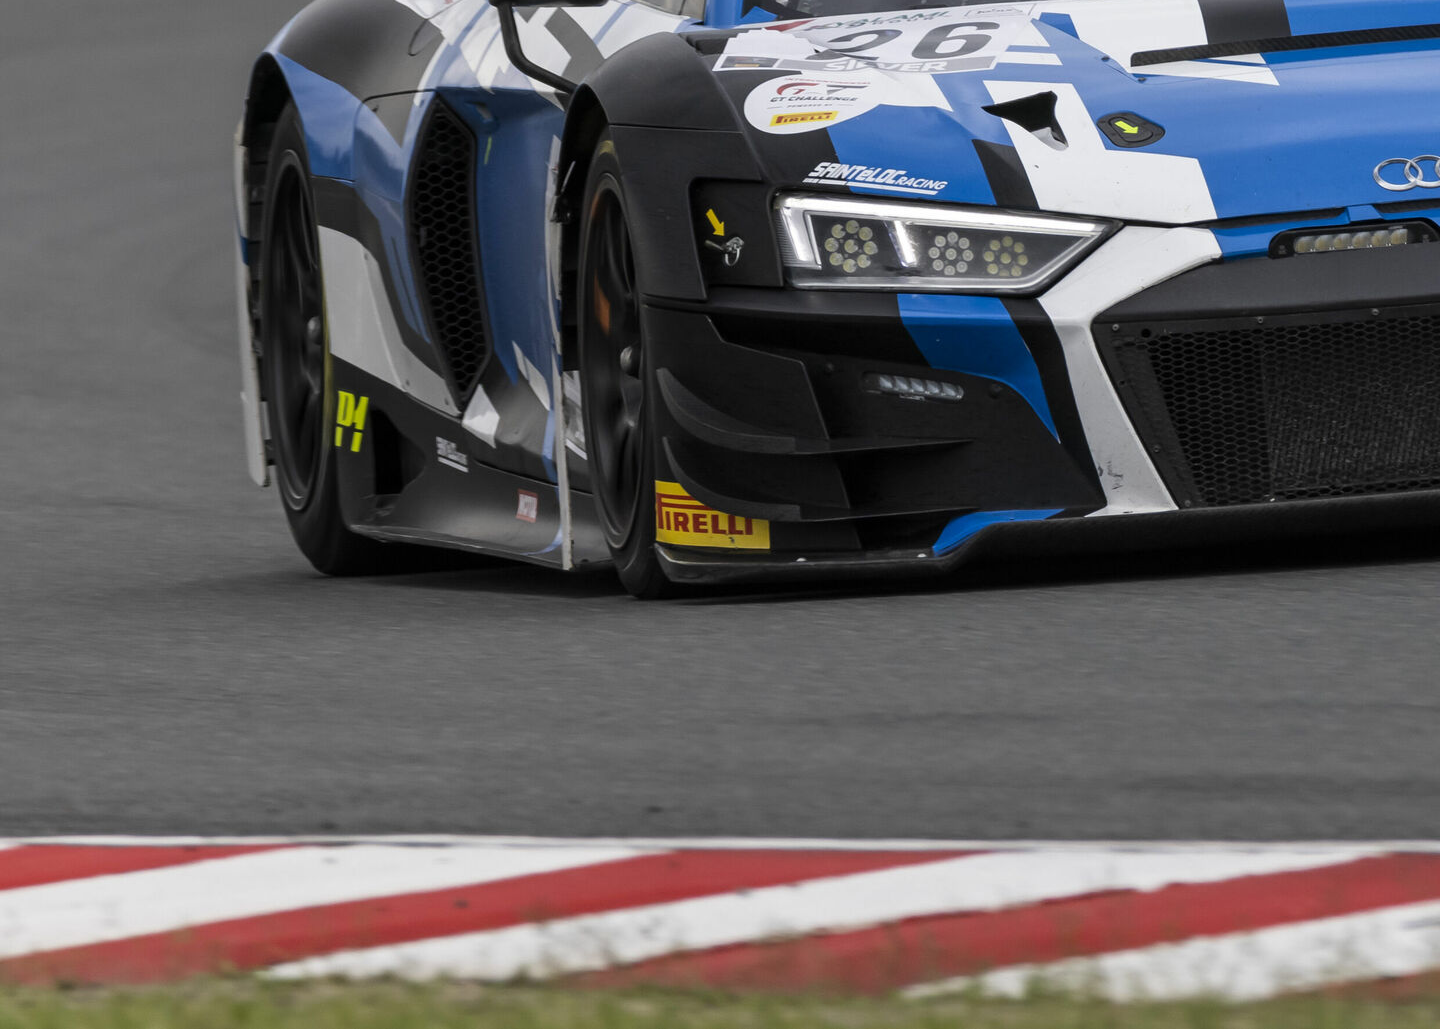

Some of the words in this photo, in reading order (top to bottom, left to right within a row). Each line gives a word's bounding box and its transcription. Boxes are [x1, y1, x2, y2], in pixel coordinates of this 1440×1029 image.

[804, 21, 1001, 61] 26
[823, 58, 949, 72] SILVER
[788, 95, 859, 103] CHALLENGE
[775, 112, 834, 124] PIRELLI
[895, 176, 949, 191] RACING
[655, 492, 753, 536] PIRELLI
